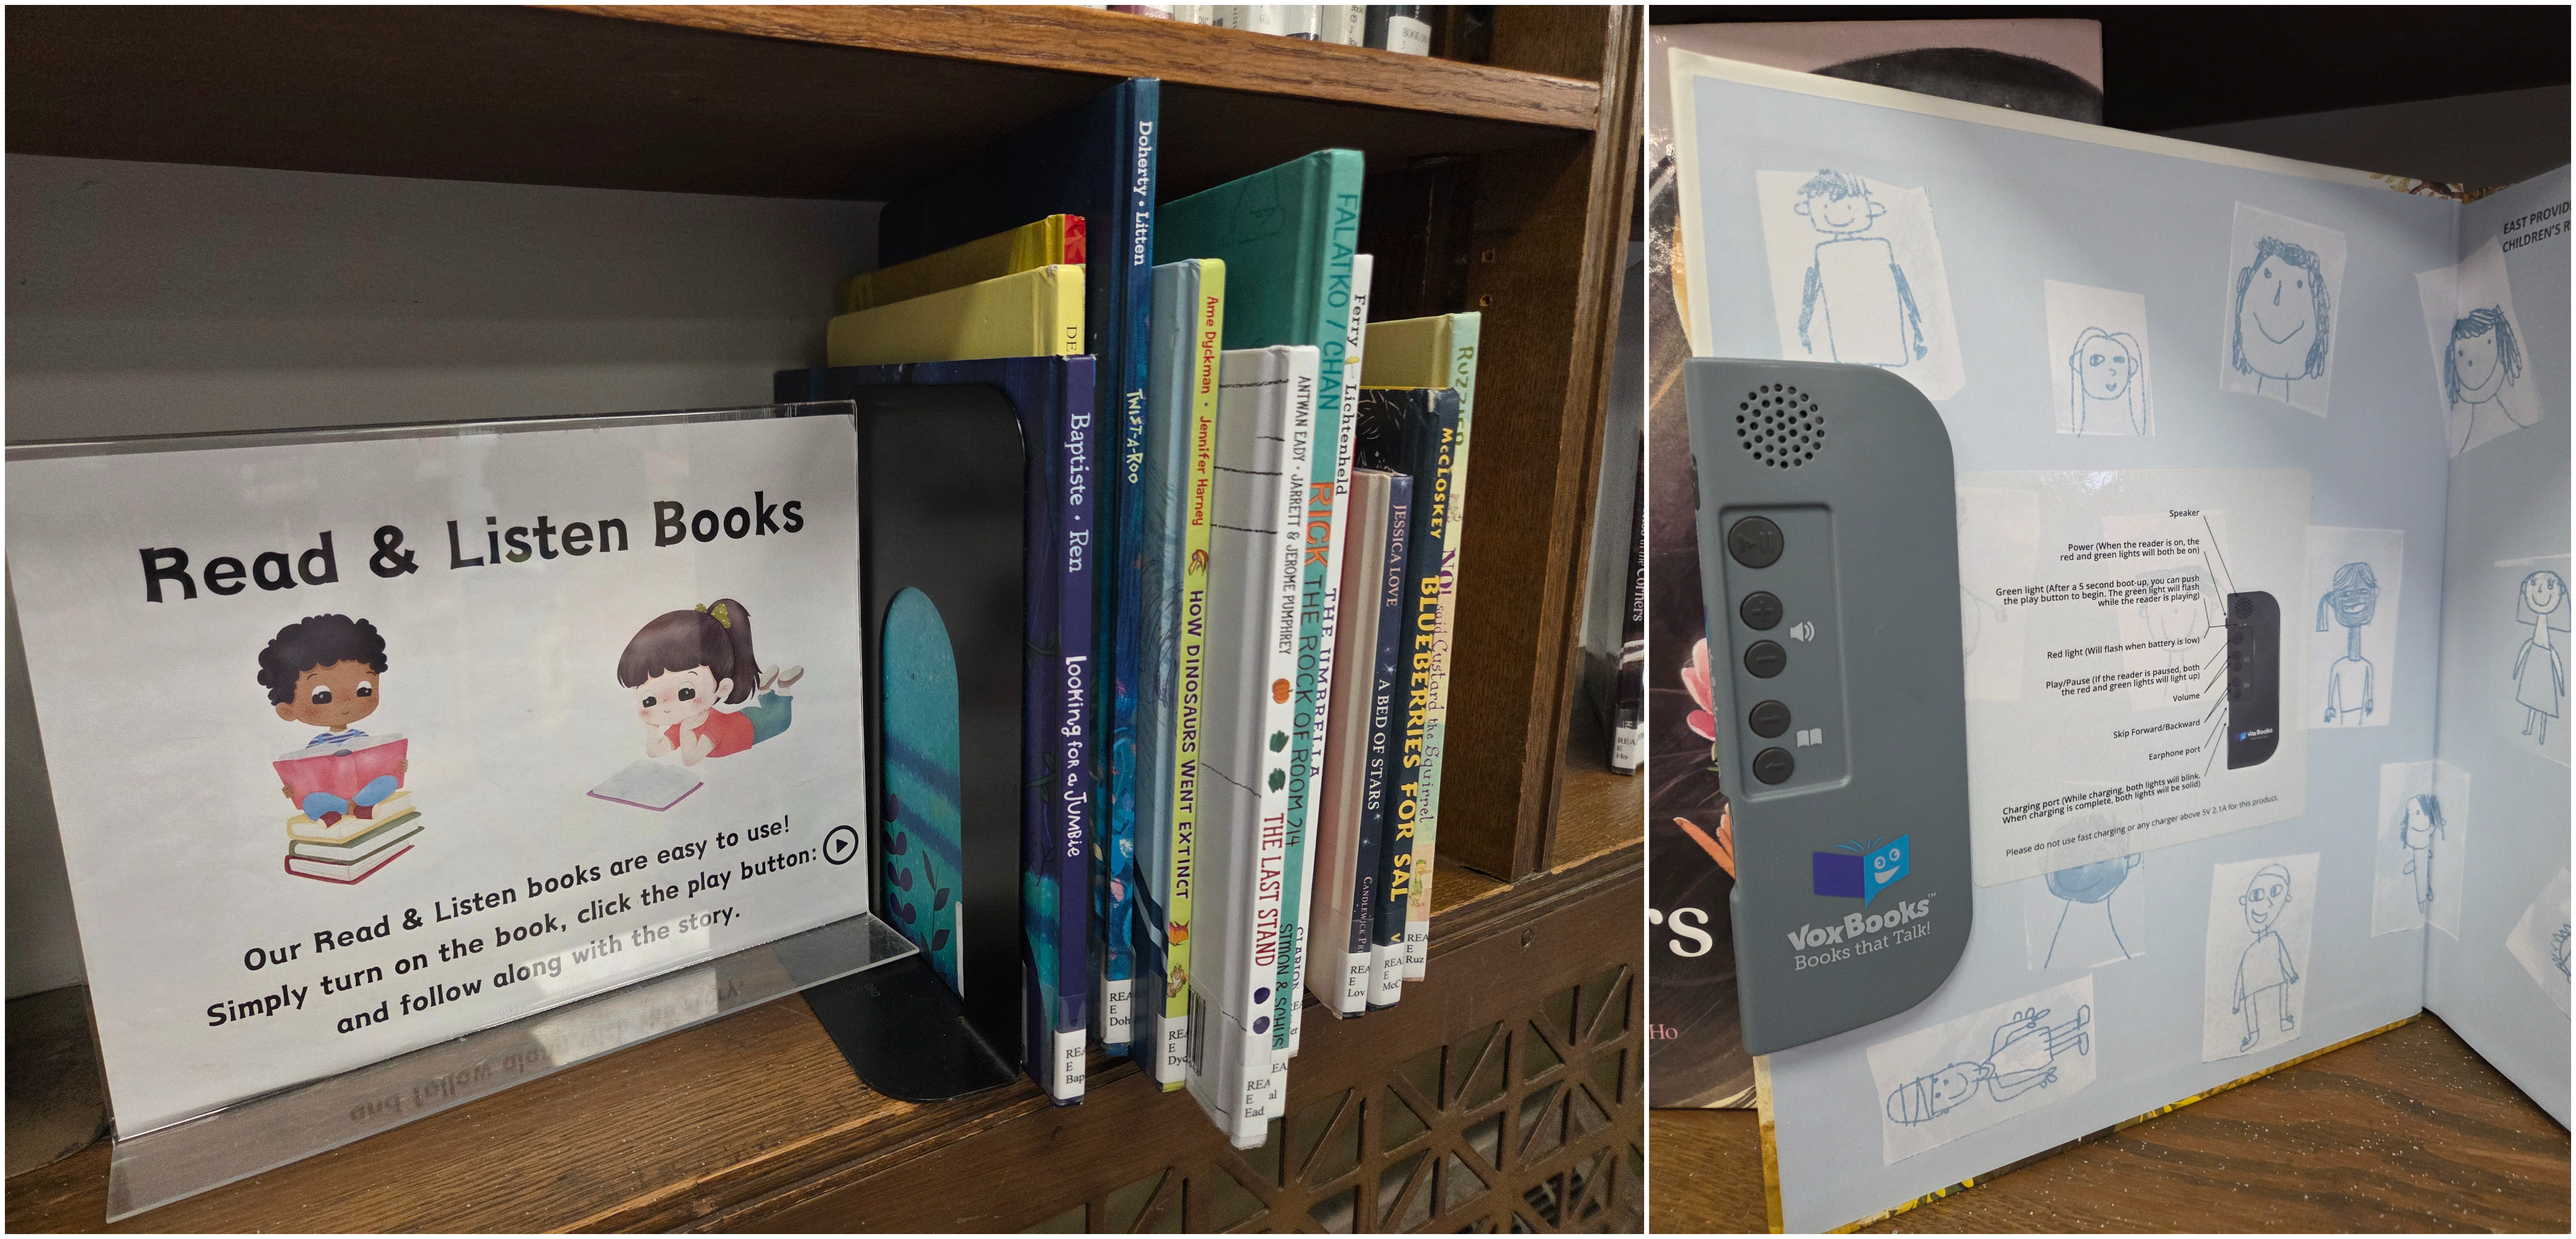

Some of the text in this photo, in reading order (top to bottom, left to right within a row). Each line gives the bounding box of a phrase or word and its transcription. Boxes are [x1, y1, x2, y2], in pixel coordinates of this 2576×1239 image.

[1134, 122, 1152, 266] Doherty Litten
[2503, 201, 2571, 235] EAST PROVID
[1327, 193, 1358, 309] FALATKO
[2502, 220, 2571, 253] CHILDREN'S R
[1318, 340, 1345, 411] CHAN
[1336, 295, 1366, 496] Ferry Lichtenheld
[1192, 296, 1219, 526] Ame Dyckman Jennifer Harney
[1064, 413, 1090, 573] Baptiste Ren
[1278, 375, 1311, 655] ANTWAN EADY JARRETT & JEROME PUMPHREY
[2170, 509, 2199, 519] Speaker
[139, 491, 803, 603] Read & Listen Books
[1386, 504, 1407, 607] JESSICA LOVE
[2060, 553, 2074, 561] red
[2076, 552, 2091, 560] and
[2094, 552, 2116, 561] green
[2119, 550, 2140, 559] lights
[2096, 542, 2121, 551] (When
[1321, 588, 1337, 638] THE
[1433, 605, 1447, 634] said
[1285, 481, 1335, 847] RICK THE ROCK OF ROOM 214
[1427, 639, 1449, 712] Custard
[2048, 650, 2062, 659] Red
[2065, 649, 2083, 658] light
[2085, 646, 2102, 656] (Will
[2104, 644, 2123, 653] flash
[1176, 590, 1204, 899] HOW DINOSAURS WENT EXTINCT
[1367, 678, 1390, 810] A BED OF STARS
[1390, 575, 1440, 902] BLUEBERRIES FOR SAL
[1426, 718, 1440, 739] the
[2114, 719, 2200, 738] Skip Forward/Backward
[2149, 747, 2200, 760] Earphone port
[1068, 774, 1078, 786] a
[1419, 745, 1440, 823] Squirrel
[2006, 846, 2032, 856] Please
[2047, 840, 2060, 848] not
[2078, 833, 2092, 841] fast
[2094, 827, 2125, 838] charging
[2152, 816, 2178, 826] charger
[2180, 812, 2200, 820] above
[244, 815, 788, 971] Our Read & Listen books are easy to use!
[1255, 812, 1285, 967] THE LAST STAND
[1358, 876, 1372, 935] CANDLEWICK
[207, 848, 816, 1026] Simply turn on the book, click the play button:
[1407, 944, 1413, 953] E
[1794, 921, 1931, 971] Books that Talk!
[337, 906, 741, 1033] and follow along with the story.
[1272, 923, 1293, 1049] SIMON & SCHUS
[1347, 988, 1365, 998] Lov
[1349, 977, 1356, 986] E
[1109, 1016, 1131, 1027] Doh
[1110, 1005, 1117, 1014] E
[1649, 1023, 1678, 1040] Ho
